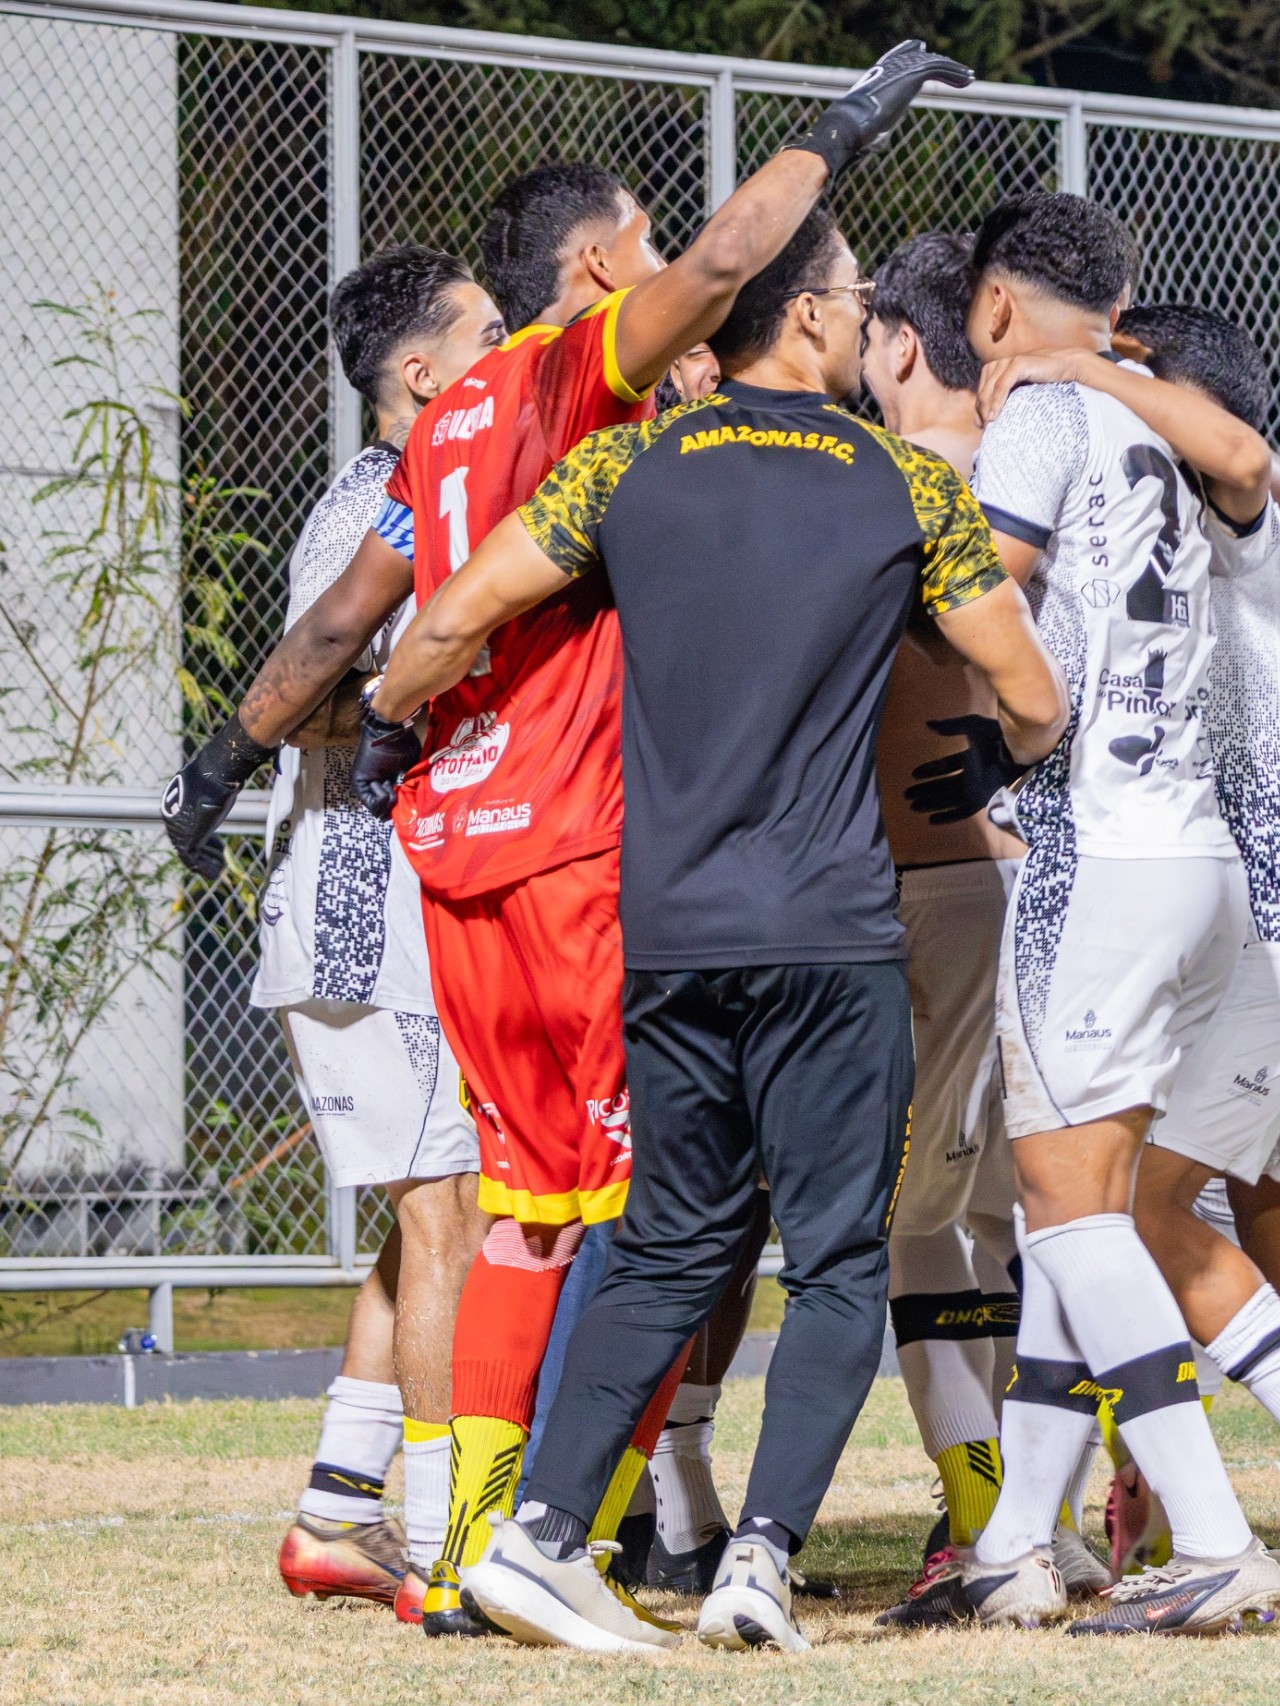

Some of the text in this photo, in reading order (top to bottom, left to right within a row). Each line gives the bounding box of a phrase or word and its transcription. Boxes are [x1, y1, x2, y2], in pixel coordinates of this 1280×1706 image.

[680, 425, 821, 454] AMAZONAS
[1089, 472, 1108, 567] serac
[1099, 668, 1142, 688] Casa
[467, 803, 531, 827] Manaus
[1066, 1028, 1112, 1041] Manaus
[1233, 1073, 1270, 1097] Manaus
